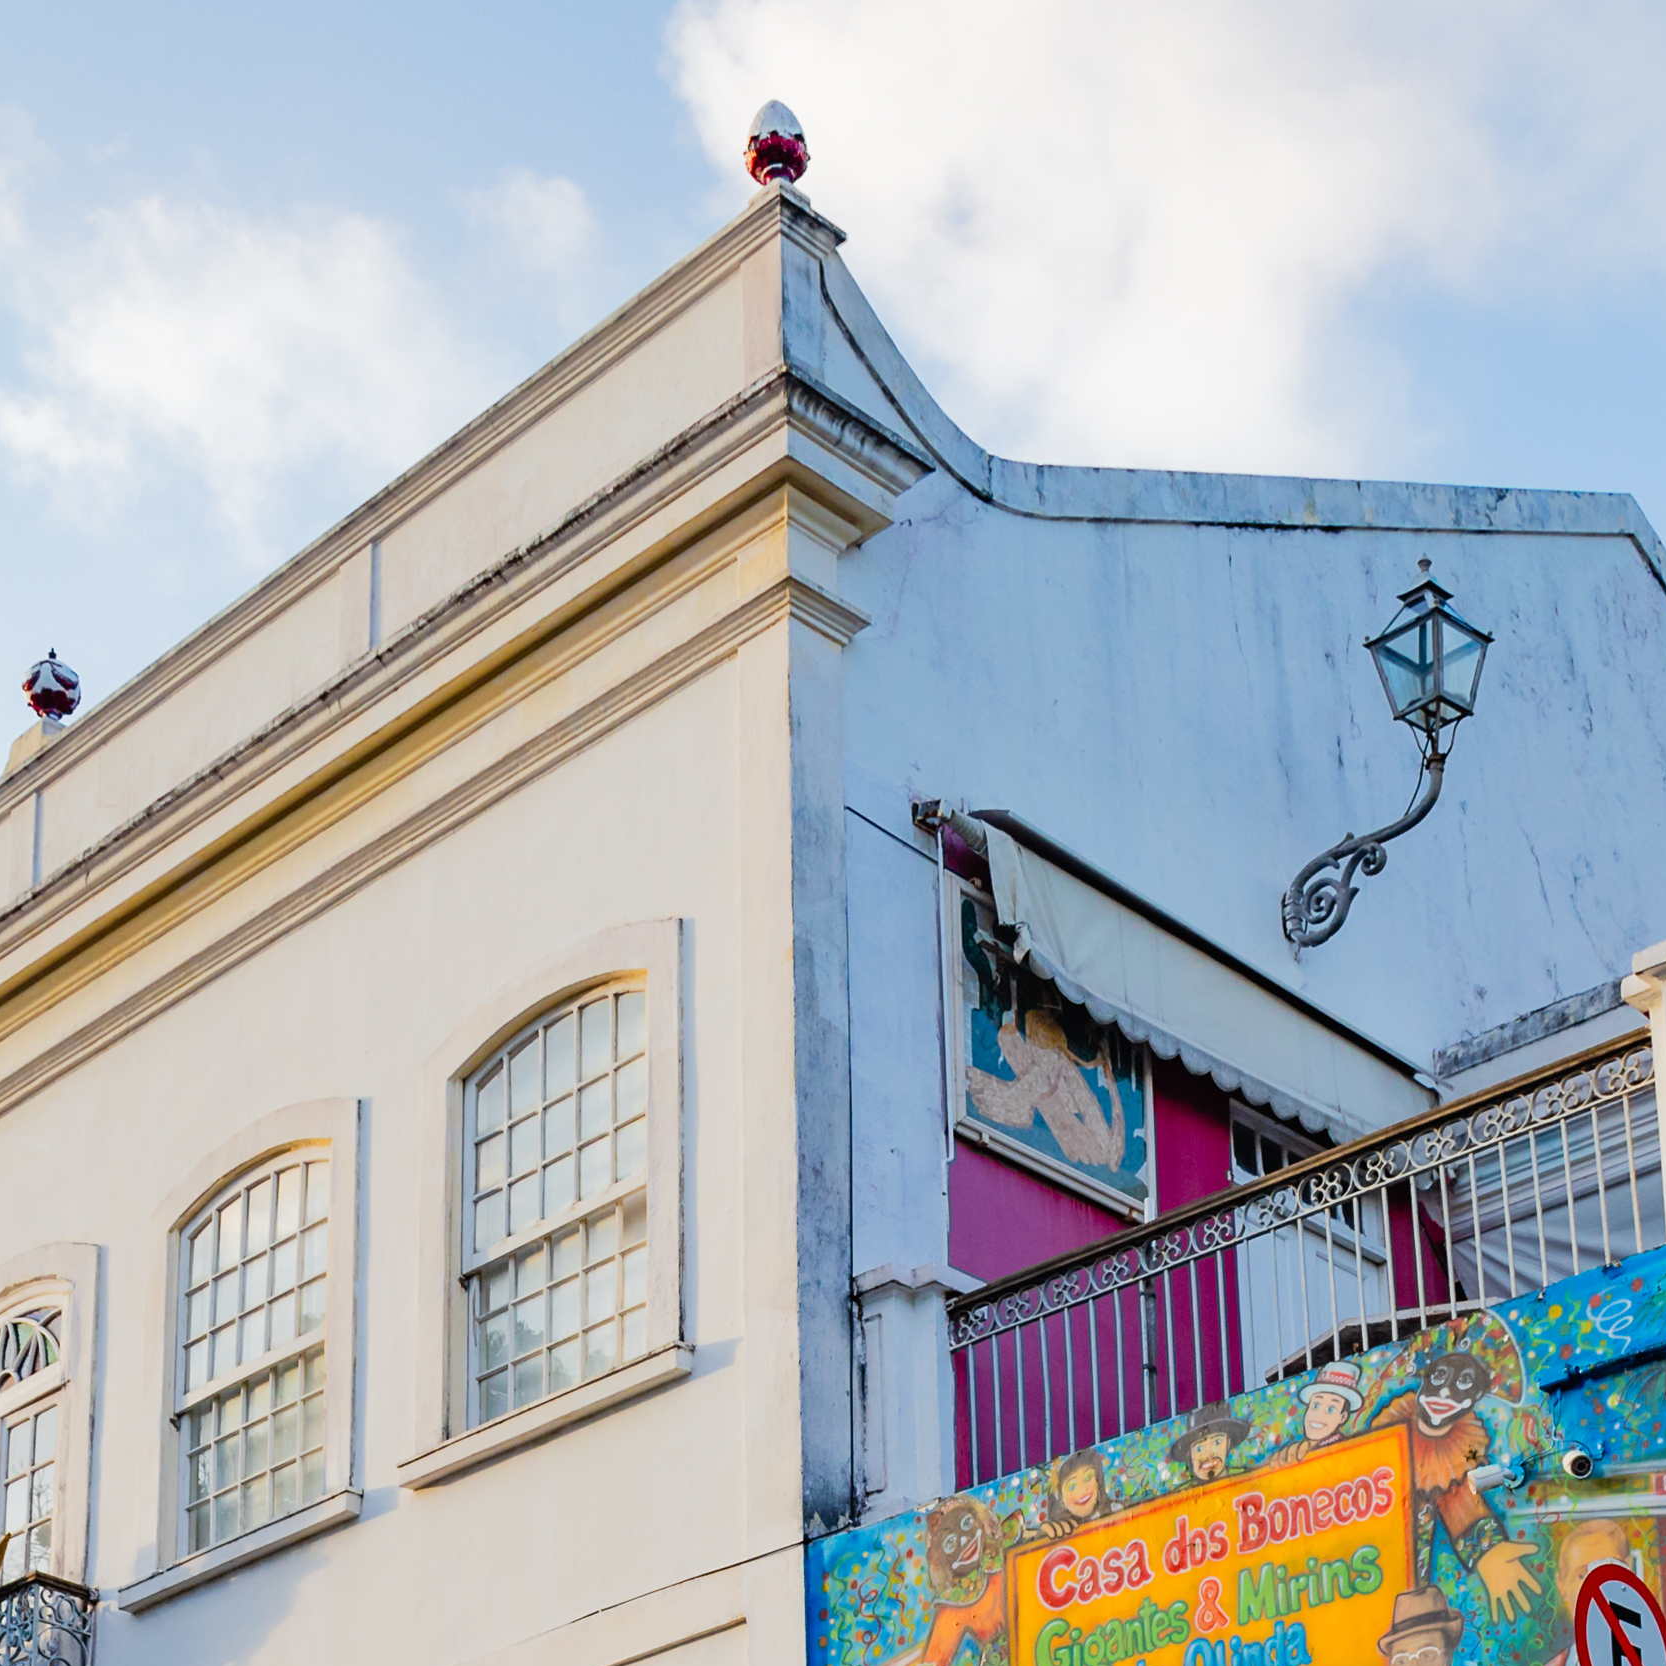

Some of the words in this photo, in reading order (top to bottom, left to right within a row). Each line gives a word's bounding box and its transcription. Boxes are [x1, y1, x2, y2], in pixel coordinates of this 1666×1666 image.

[1036, 1539, 1154, 1610] Casa
[1163, 1515, 1229, 1574] dos
[1234, 1467, 1395, 1555] Bonecos
[1195, 1576, 1229, 1632] &
[1237, 1545, 1383, 1626] Mirins
